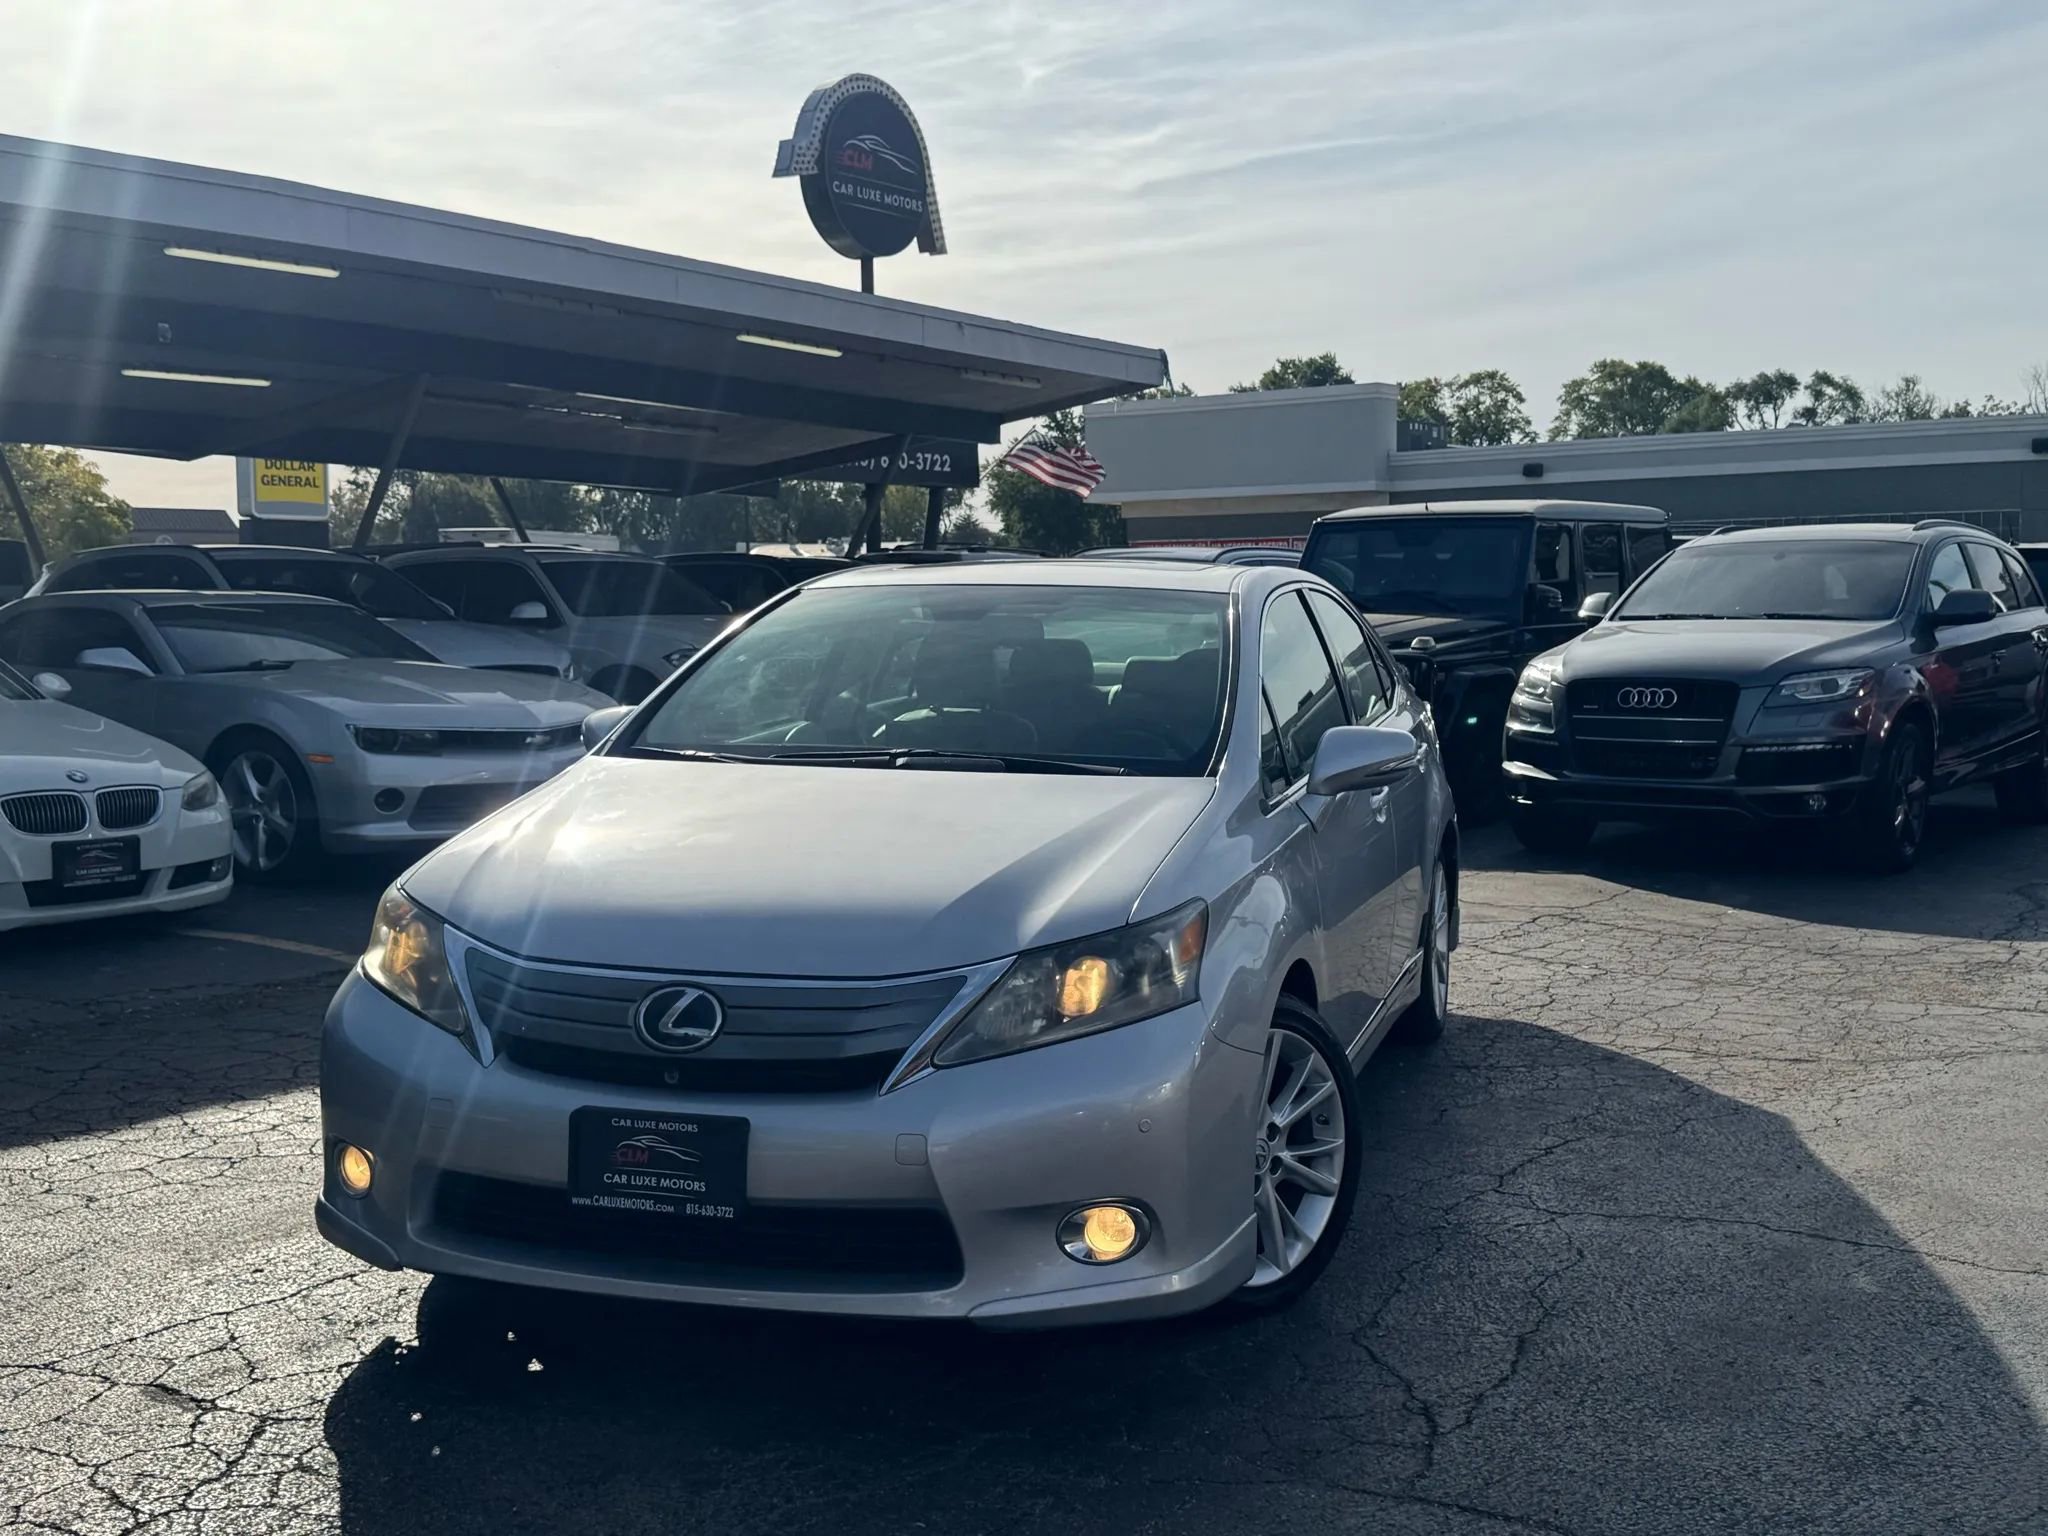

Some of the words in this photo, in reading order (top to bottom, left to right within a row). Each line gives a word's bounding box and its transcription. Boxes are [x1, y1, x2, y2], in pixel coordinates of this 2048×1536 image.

[832, 180, 853, 196] CAR
[857, 186, 881, 202] LUXE
[884, 192, 923, 212] MOTORS
[264, 459, 316, 472] DOLLAR
[261, 474, 319, 488] GENERAL
[611, 1117, 632, 1128] CAR
[634, 1120, 657, 1130] LUXE
[658, 1122, 699, 1133] MOTORS
[603, 1173, 628, 1185] CAR
[631, 1175, 657, 1187] LUXE
[660, 1178, 706, 1192] MOTORS
[685, 1203, 734, 1218] 815-630-3722
